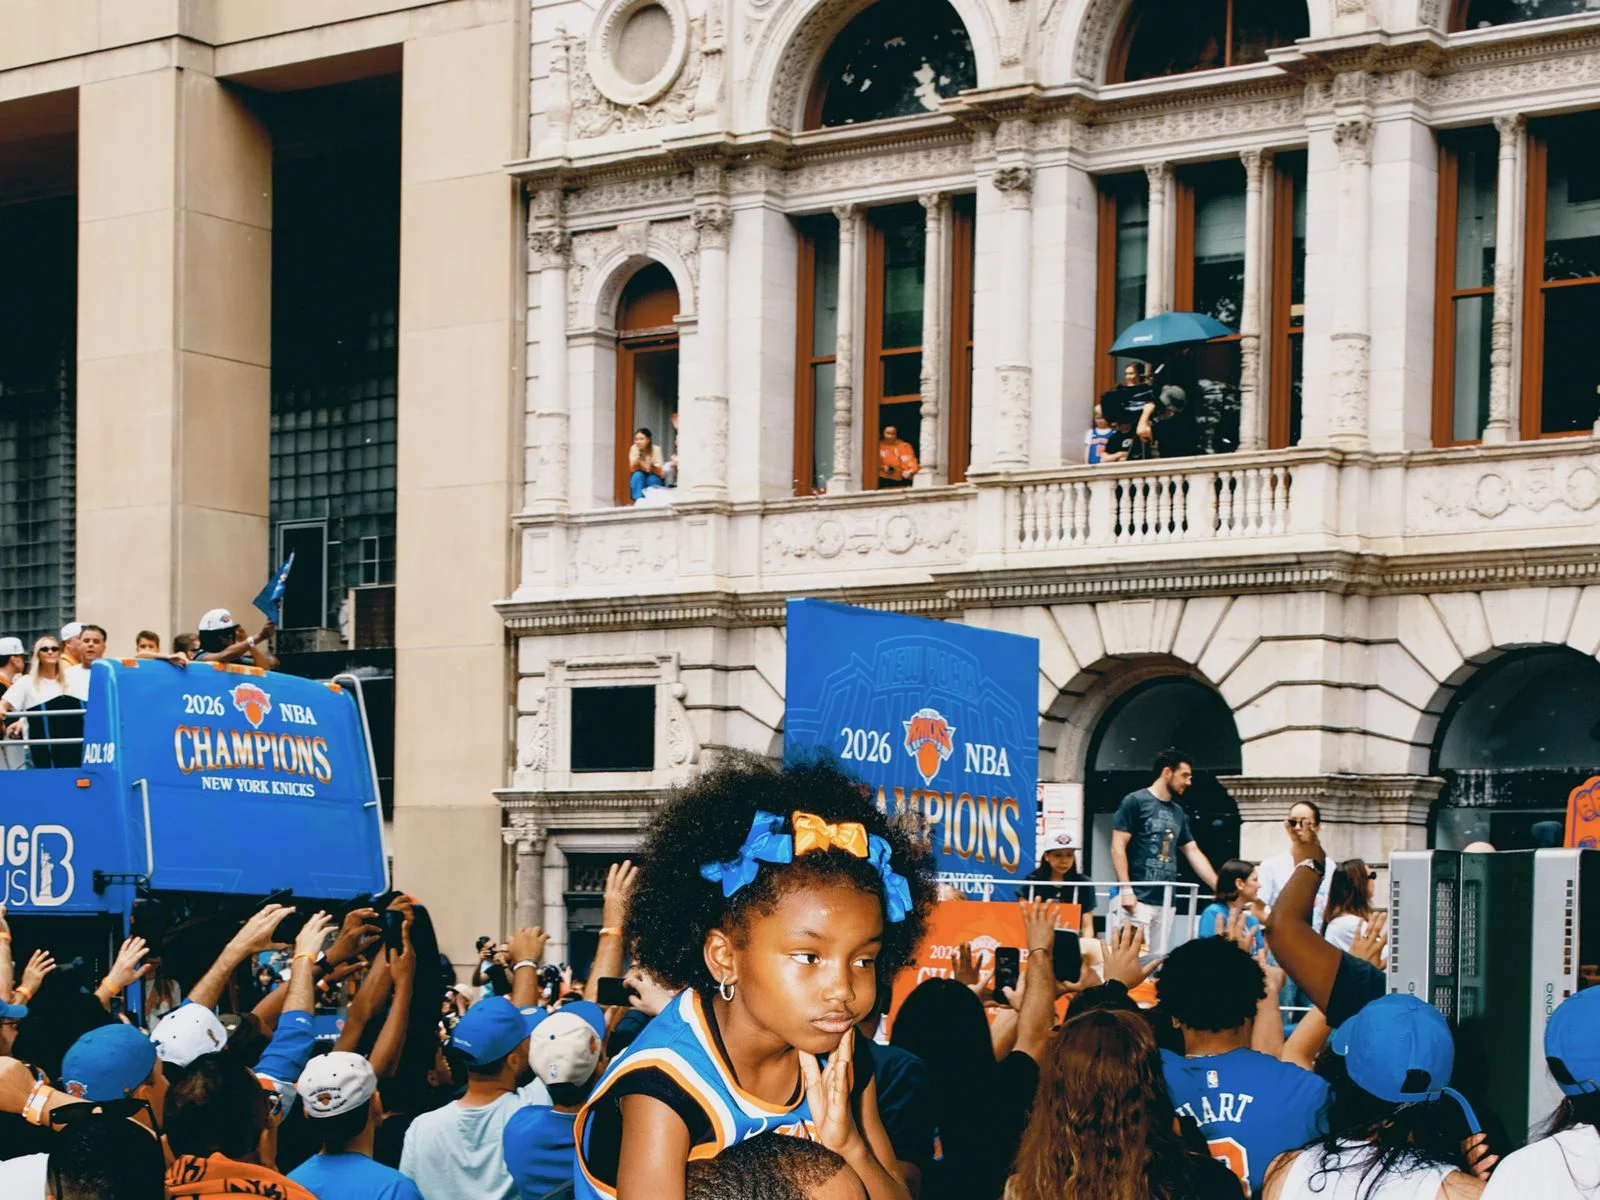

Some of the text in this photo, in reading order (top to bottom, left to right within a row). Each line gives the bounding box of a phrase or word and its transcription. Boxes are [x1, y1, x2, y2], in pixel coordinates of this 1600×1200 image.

[183, 694, 225, 717] 2026
[281, 703, 317, 726] NBA
[83, 742, 115, 764] ADL18
[174, 725, 332, 784] CHAMPIONS
[840, 727, 1012, 777] 2026 NBA
[202, 776, 315, 798] NEW YORK KNICKS
[876, 783, 1021, 874] MPIONS
